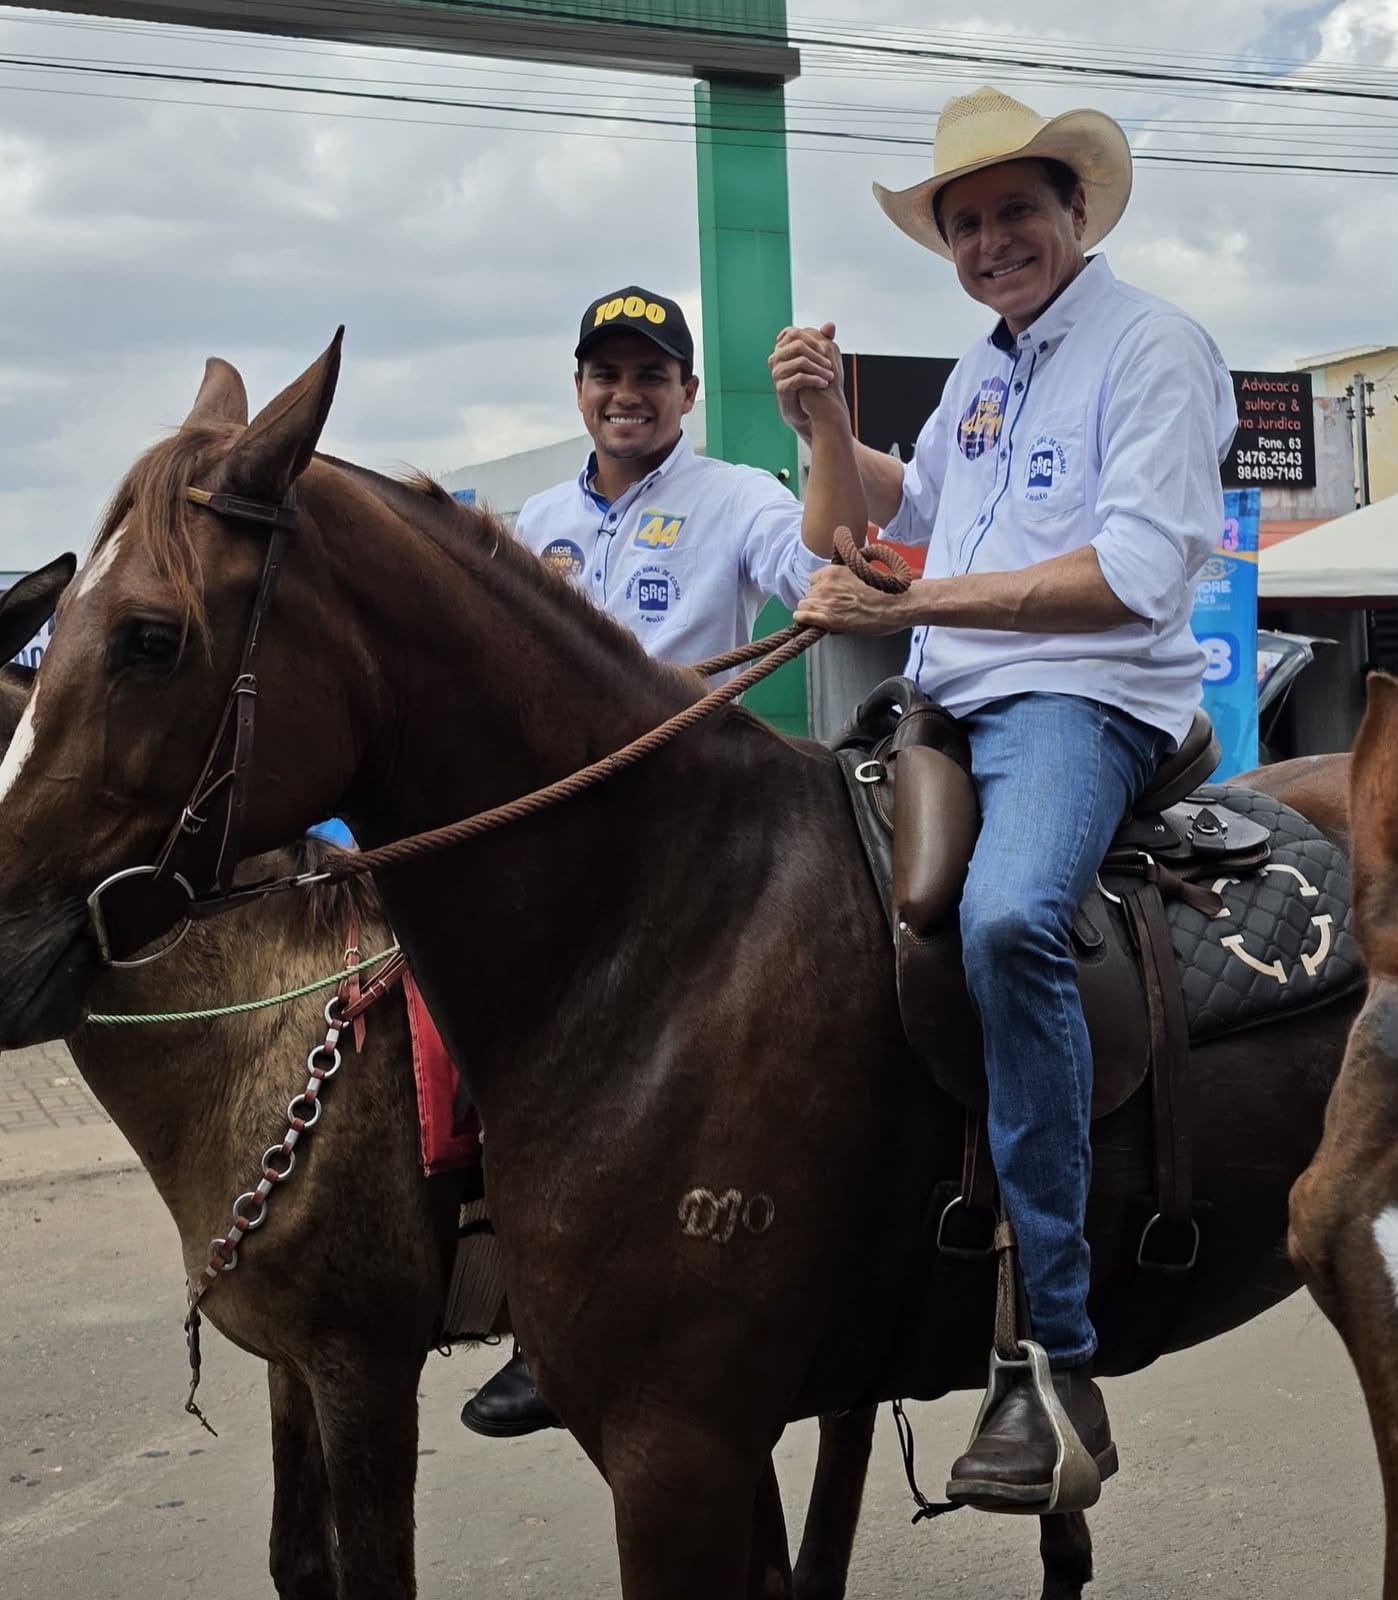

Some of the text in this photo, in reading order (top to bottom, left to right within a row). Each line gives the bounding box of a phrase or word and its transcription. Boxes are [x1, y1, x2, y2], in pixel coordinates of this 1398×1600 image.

[594, 296, 666, 327] 1000
[1291, 399, 1300, 411] &
[1258, 436, 1302, 449] Fone. 63
[1237, 449, 1302, 465] 3476-2543
[1030, 455, 1052, 479] SRC
[1237, 465, 1303, 480] 98489-7146
[639, 516, 682, 547] 44
[551, 546, 571, 554] LUCAS
[640, 583, 668, 602] SRC
